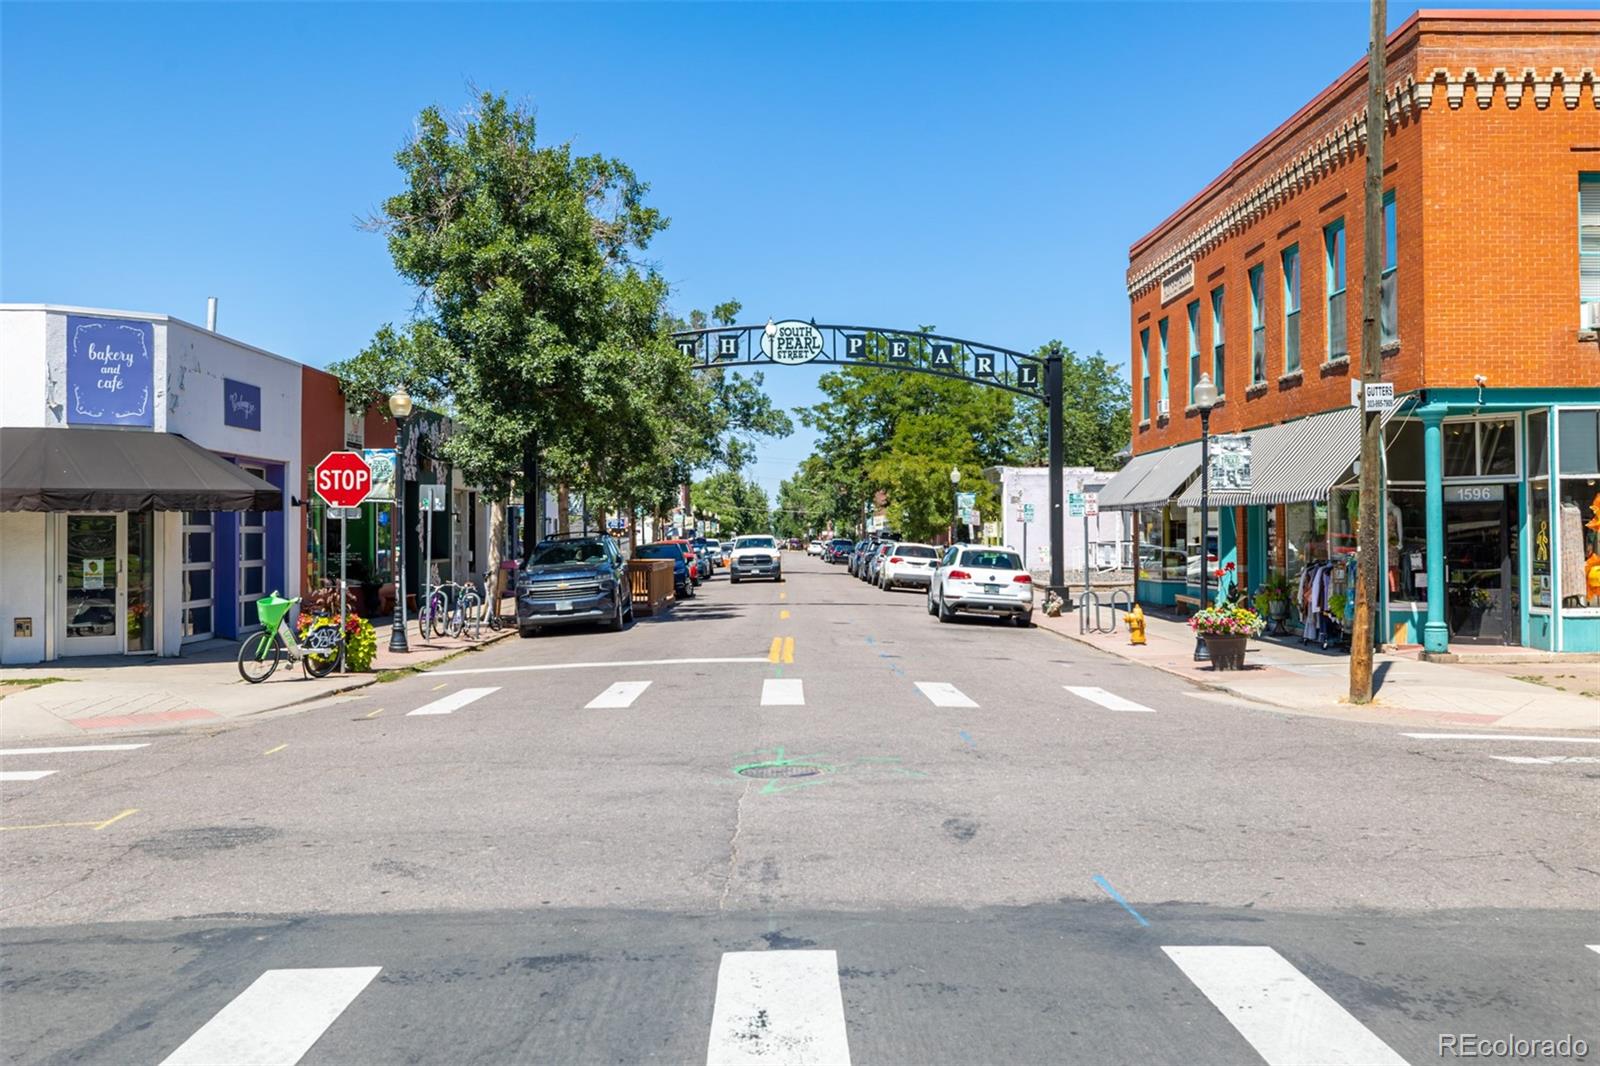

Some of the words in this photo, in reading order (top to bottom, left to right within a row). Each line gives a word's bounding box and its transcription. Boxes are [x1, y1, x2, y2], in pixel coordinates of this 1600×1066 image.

[779, 326, 813, 337] SOUTH
[777, 336, 821, 354] PEARL
[88, 342, 134, 368] bakery
[777, 350, 809, 360] STREET
[849, 338, 1036, 384] PEARL
[100, 364, 121, 374] and
[1367, 386, 1393, 396] GUTTERS
[319, 469, 368, 491] STOP
[1457, 488, 1490, 500] 1596
